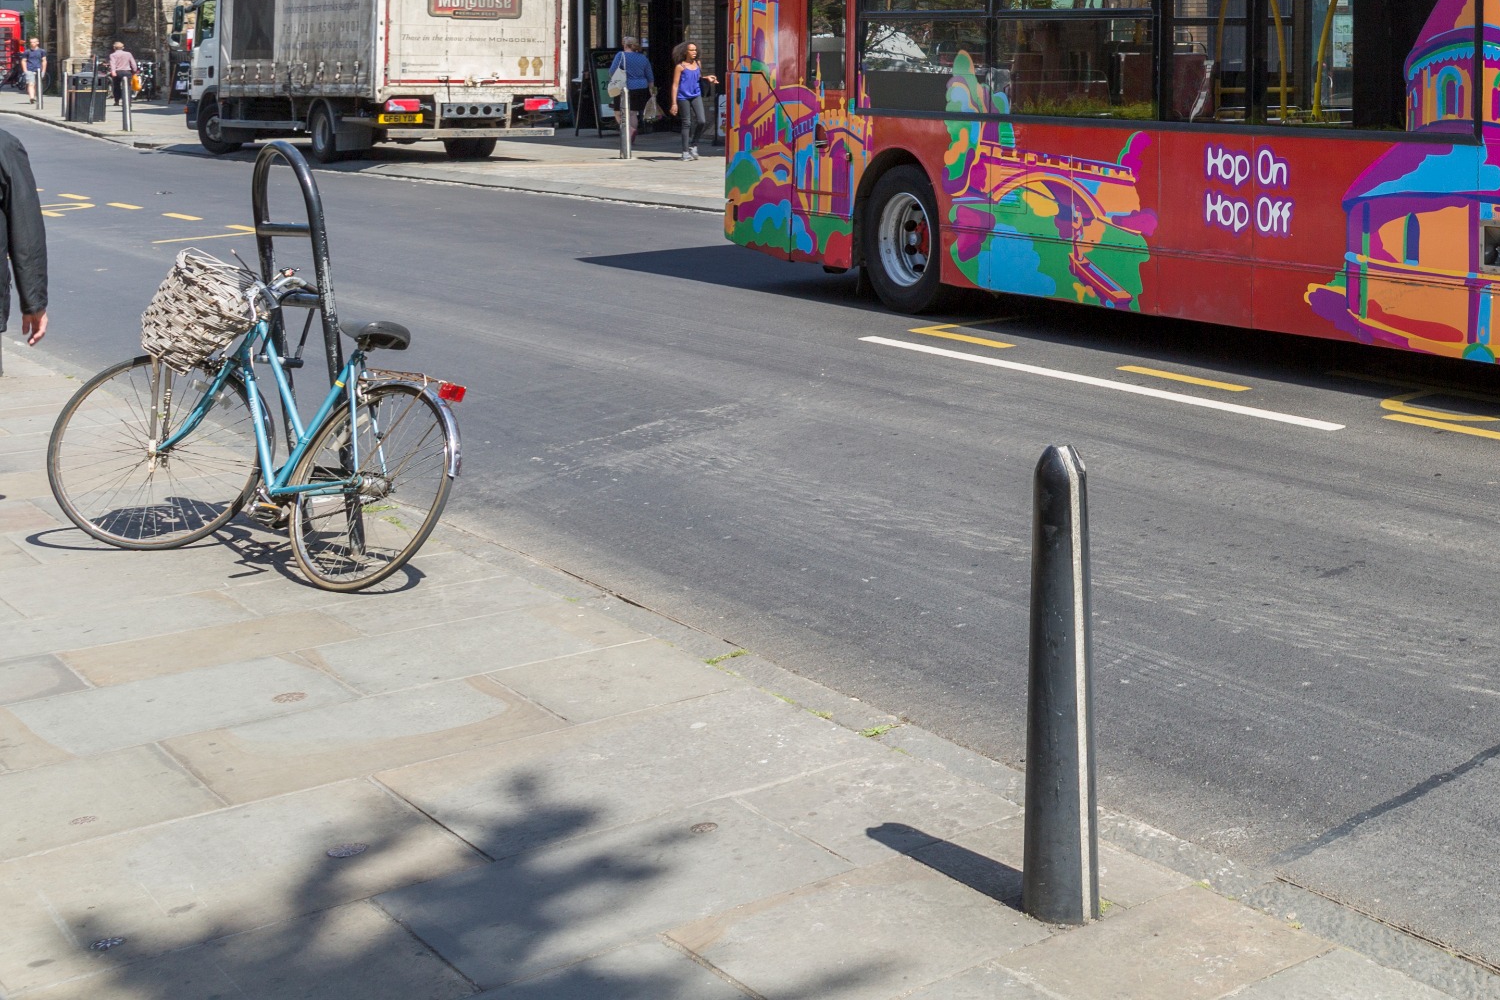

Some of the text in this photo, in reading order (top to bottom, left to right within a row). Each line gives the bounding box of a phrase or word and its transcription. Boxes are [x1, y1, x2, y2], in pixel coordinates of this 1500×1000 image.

[401, 33, 421, 41] Those
[432, 33, 443, 41] the
[465, 34, 486, 42] choose
[1206, 146, 1287, 185] Hop On
[1206, 193, 1292, 233] Hop Off
